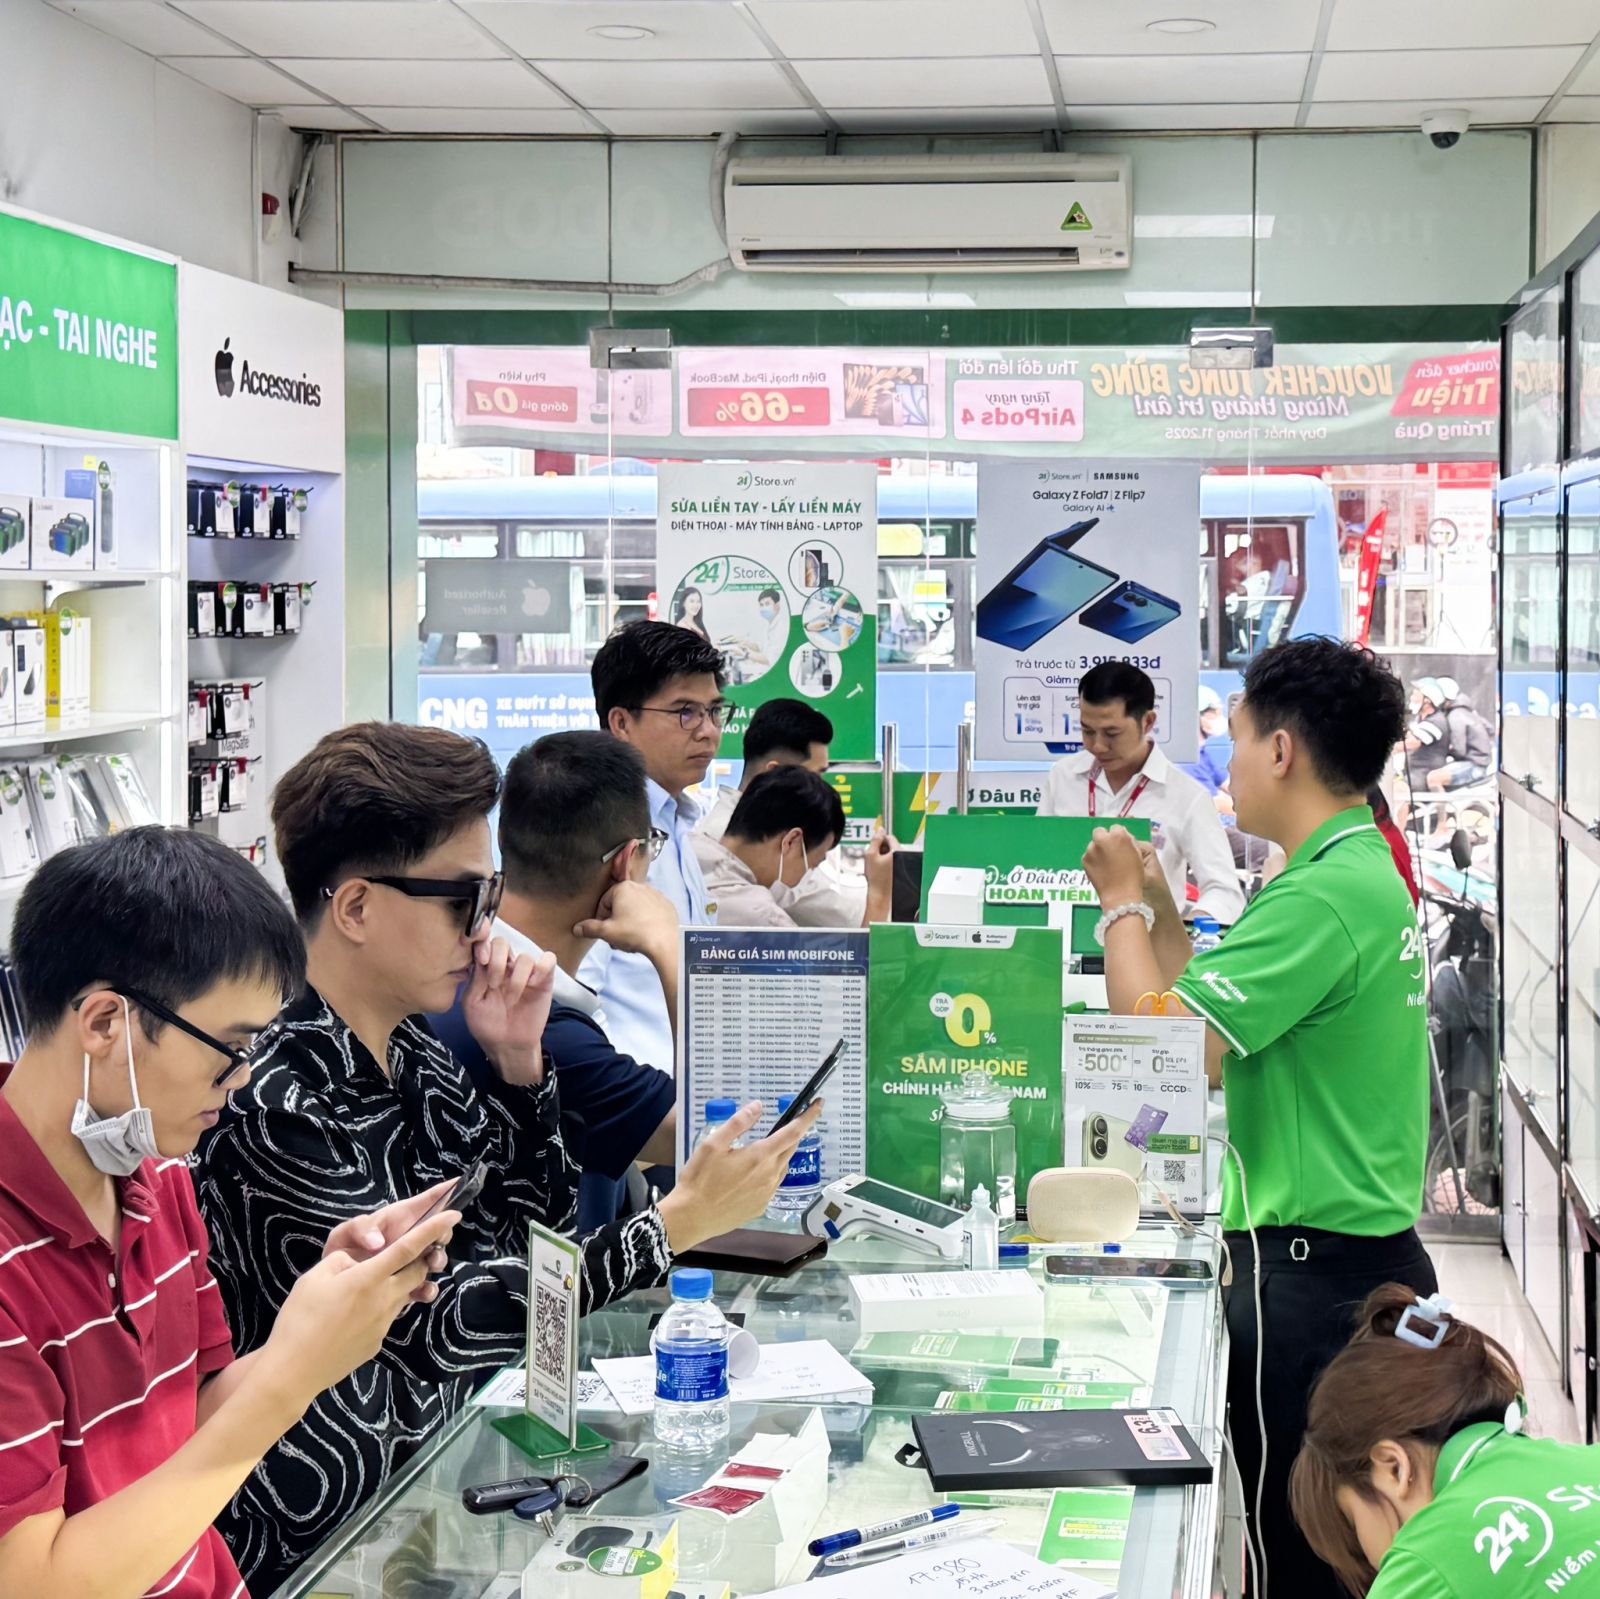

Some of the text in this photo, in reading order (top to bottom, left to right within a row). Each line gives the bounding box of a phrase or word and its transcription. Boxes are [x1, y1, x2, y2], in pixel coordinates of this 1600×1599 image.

[53, 308, 89, 355] TAI
[95, 319, 158, 369] NGHE
[240, 360, 321, 407] Accessories
[1093, 472, 1139, 480] SAMSUNG
[1033, 490, 1145, 502] Galaxy Z Fold7 Z Flip7
[735, 501, 759, 513] TAY
[771, 495, 796, 513] LẤY
[832, 496, 862, 514] MÁY
[1063, 504, 1094, 513] Galaxy
[671, 519, 694, 532] ĐIỆN
[696, 521, 727, 533] THOẠI
[736, 519, 760, 531] MÁY
[762, 519, 785, 531] TÍNH
[823, 522, 863, 532] LAPTOP
[1016, 659, 1032, 669] Trả
[1034, 659, 1062, 669] trước
[496, 697, 513, 711] XE
[420, 697, 489, 730] CNG
[221, 735, 249, 754] MagSafe
[979, 788, 1015, 803] Đâu
[989, 886, 1044, 901] HOÀN
[701, 946, 855, 961] BẢNG GIÁ SIM MOBIFONE
[951, 1058, 1028, 1077] IPHONE
[882, 1078, 929, 1096] CHÍNH
[1013, 1086, 1047, 1099] NAM
[1075, 1081, 1187, 1093] 10% 75 10 CCCD
[909, 1557, 981, 1586] 17.980
